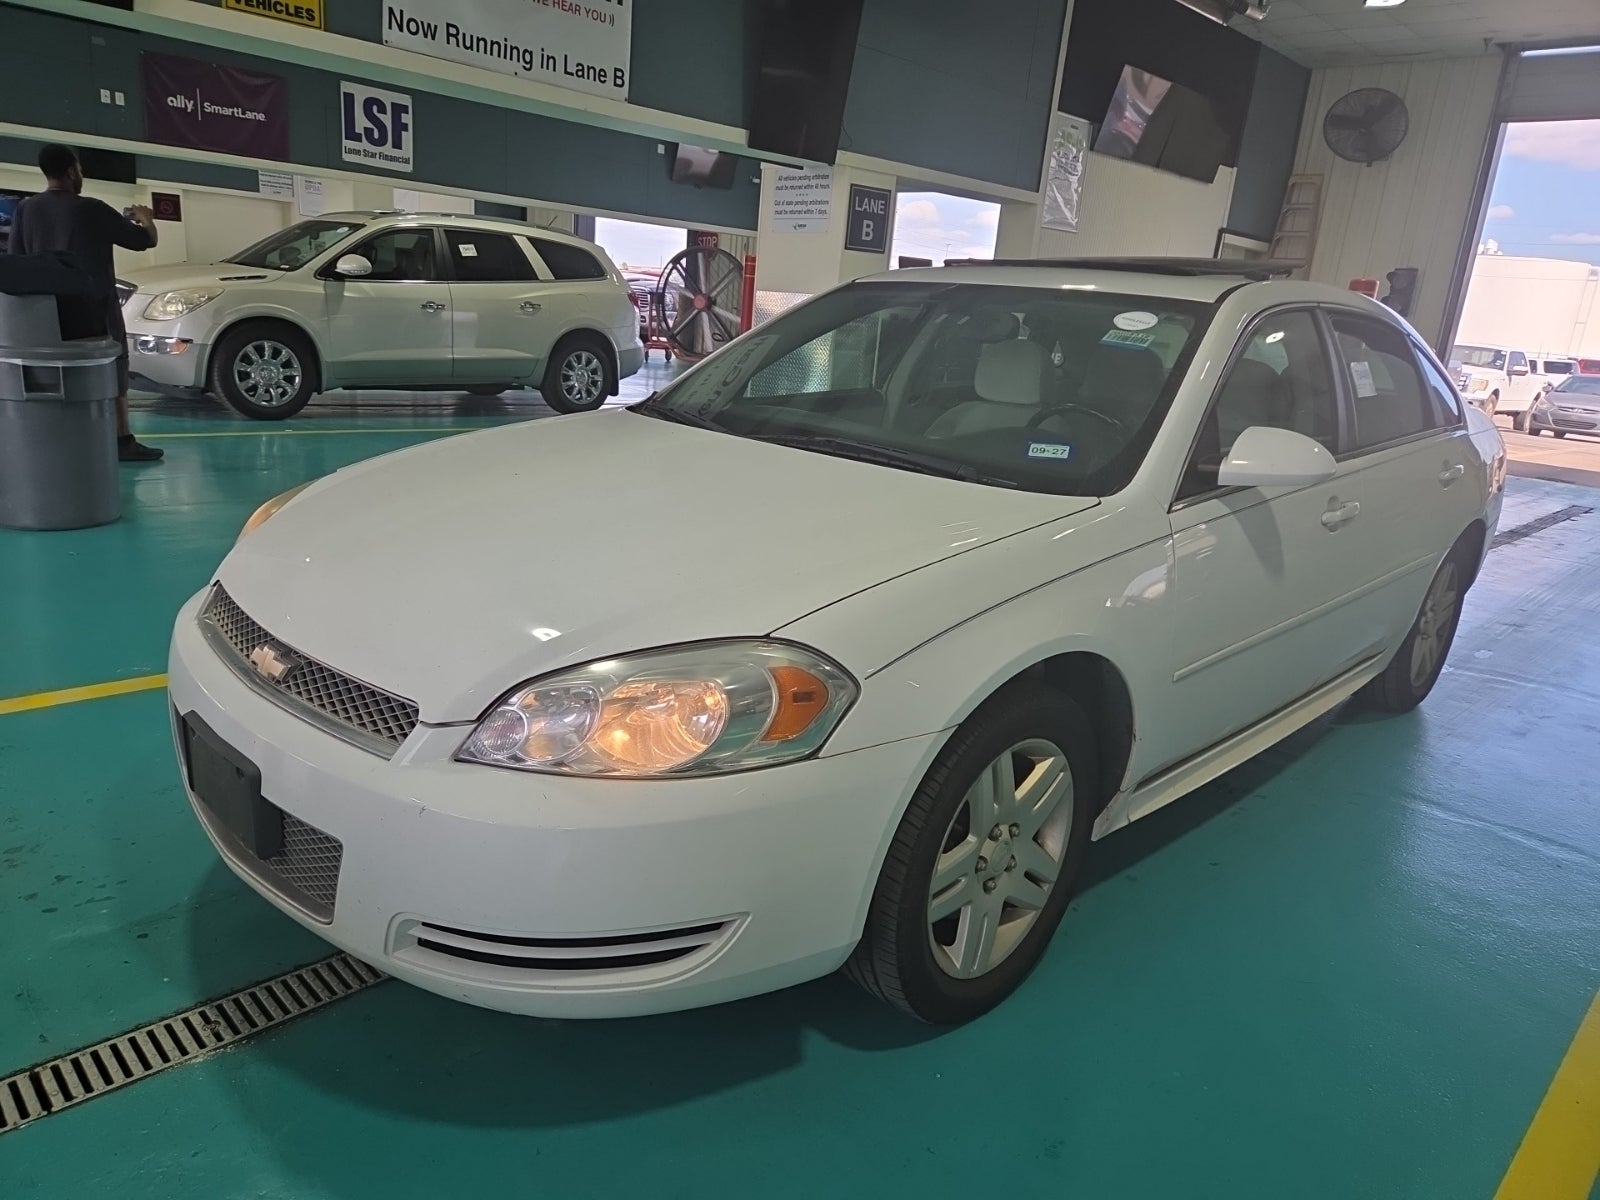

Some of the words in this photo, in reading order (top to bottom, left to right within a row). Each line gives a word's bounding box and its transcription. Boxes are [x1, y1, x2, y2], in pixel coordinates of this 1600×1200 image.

[553, 0, 581, 16] HEAR
[584, 7, 607, 23] YOU
[388, 6, 438, 41] Now
[446, 22, 533, 71] Running
[540, 48, 557, 72] in
[564, 54, 607, 84] Lane
[613, 67, 625, 88] B
[167, 94, 193, 112] ally
[204, 102, 266, 121] SmartLane
[343, 91, 409, 150] LSF
[344, 146, 362, 157] Lone
[363, 148, 377, 159] Star
[379, 152, 410, 164] Financial
[855, 196, 886, 215] LANE
[861, 219, 874, 241] B
[697, 236, 718, 248] STOP
